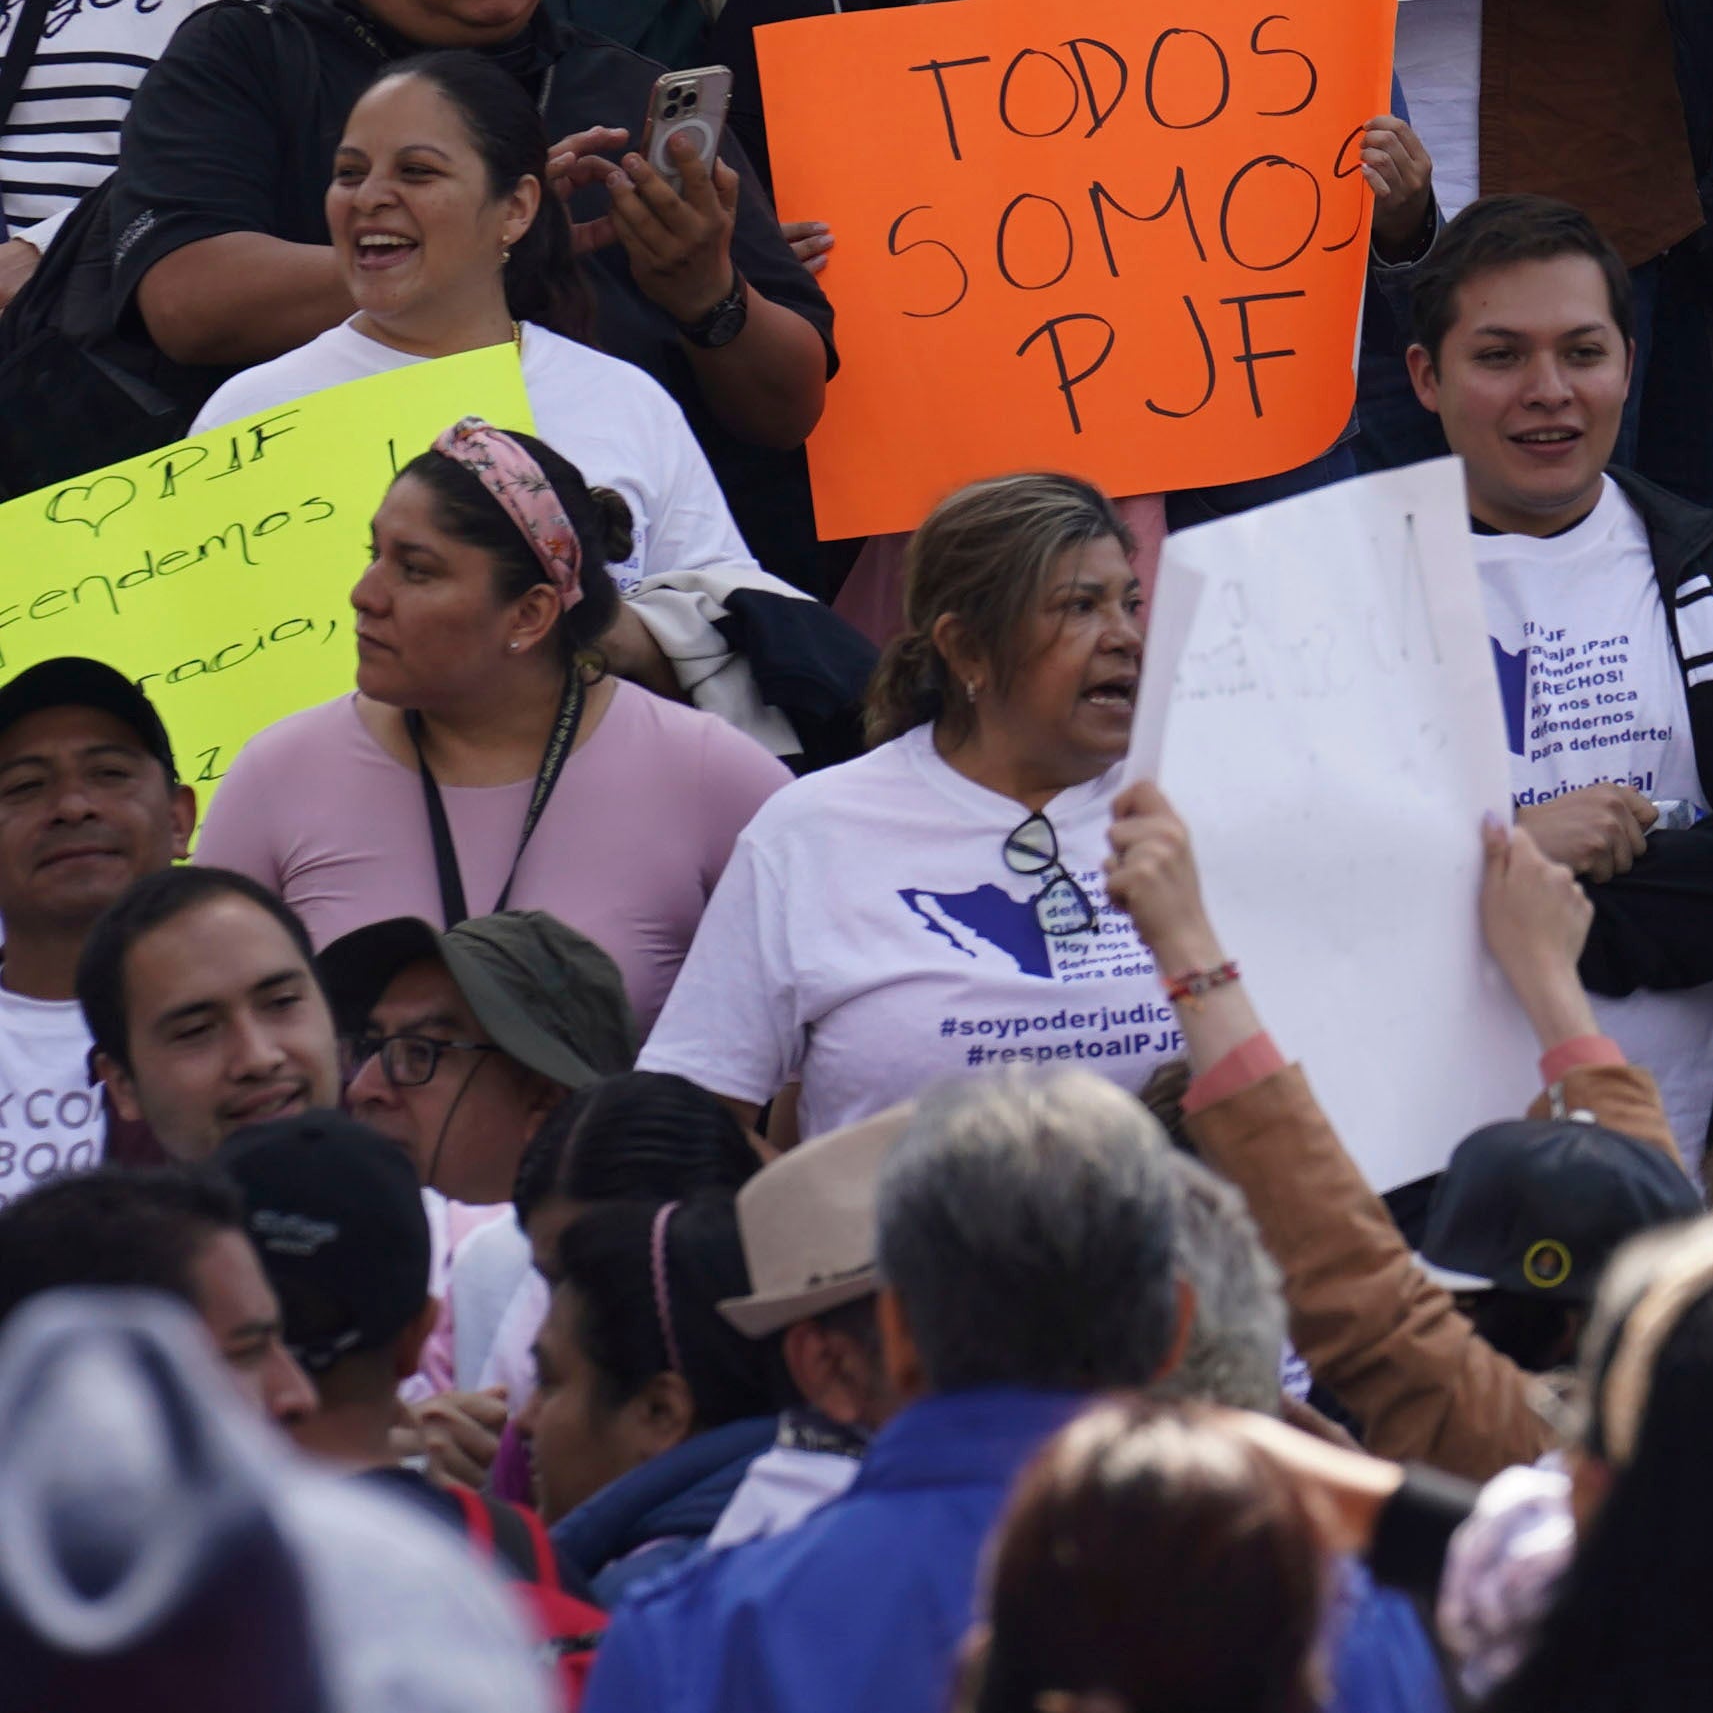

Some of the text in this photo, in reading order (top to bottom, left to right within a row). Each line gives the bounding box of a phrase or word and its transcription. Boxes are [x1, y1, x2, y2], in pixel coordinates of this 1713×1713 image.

[909, 15, 1318, 161] TODOS
[888, 124, 1366, 319] SOMOS
[1016, 290, 1306, 434] PJF
[1582, 634, 1630, 655] ¡Para
[1599, 653, 1629, 668] tus
[1558, 690, 1638, 713] nos toca
[1569, 726, 1673, 753] defenderte!
